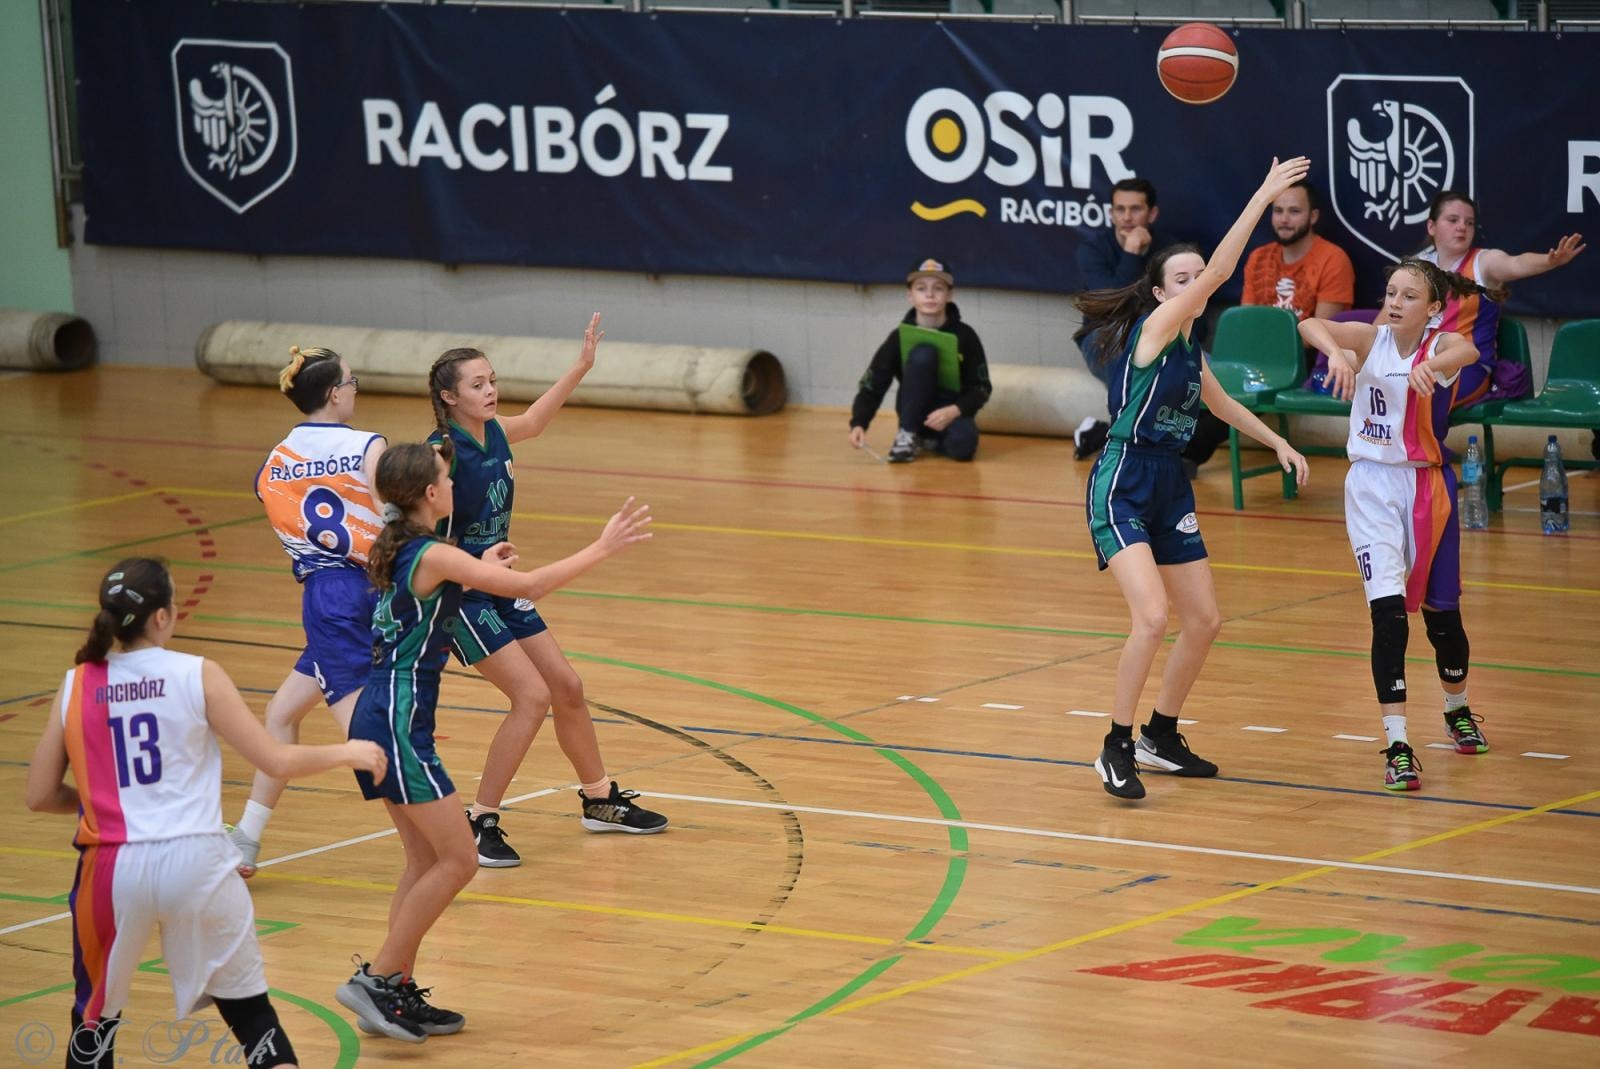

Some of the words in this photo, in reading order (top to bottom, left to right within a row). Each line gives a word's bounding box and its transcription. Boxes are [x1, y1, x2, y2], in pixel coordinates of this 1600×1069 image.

[363, 83, 733, 182] RACIBÓRZ
[1181, 381, 1200, 410] 7
[1369, 386, 1387, 417] 16
[270, 454, 363, 481] RACIBÓRZ
[486, 478, 509, 512] 10
[303, 487, 351, 557] 8
[1357, 551, 1373, 582] 16
[95, 677, 166, 704] RACIBÓRZ
[107, 712, 162, 789] 13
